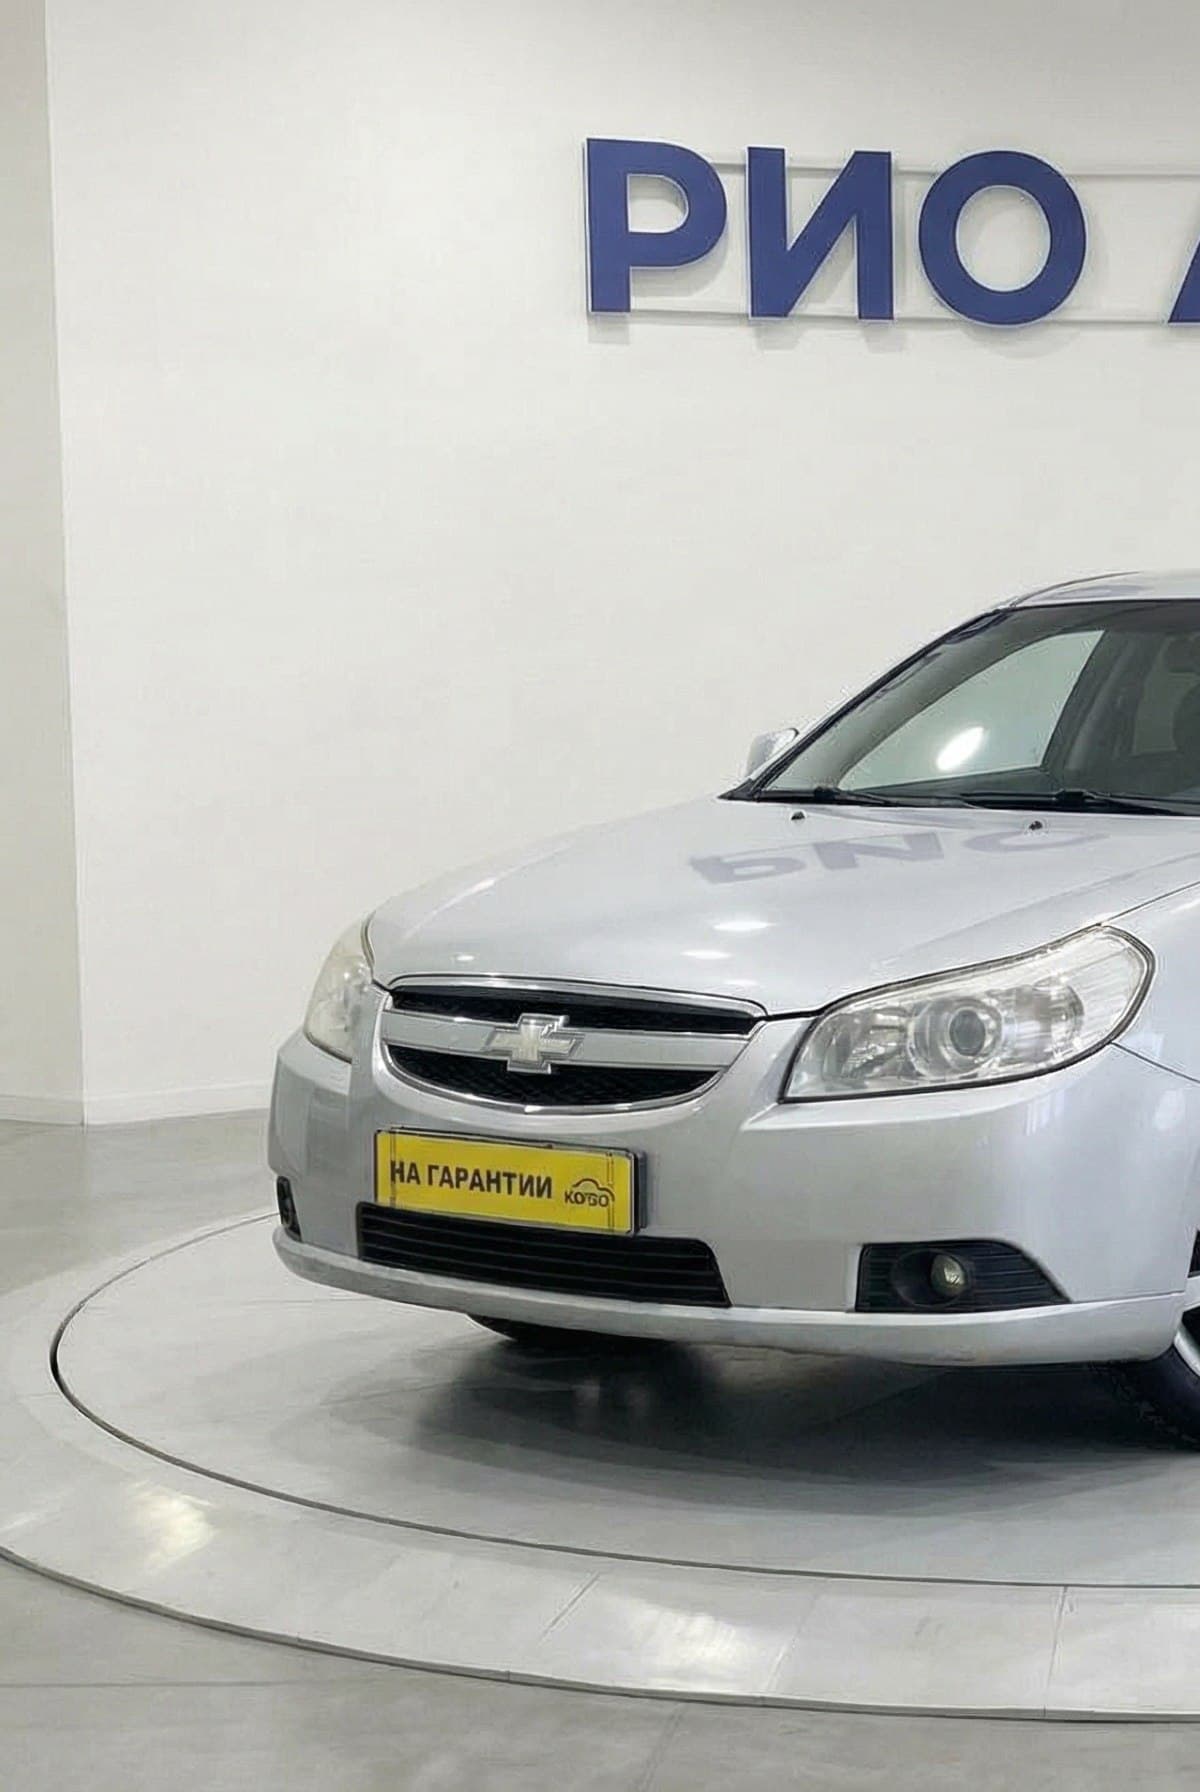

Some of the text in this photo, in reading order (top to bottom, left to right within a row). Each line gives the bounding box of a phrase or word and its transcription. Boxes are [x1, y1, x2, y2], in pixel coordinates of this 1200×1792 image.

[587, 138, 1086, 325] РИО
[390, 1160, 552, 1200] НА ГАРАНТИИ
